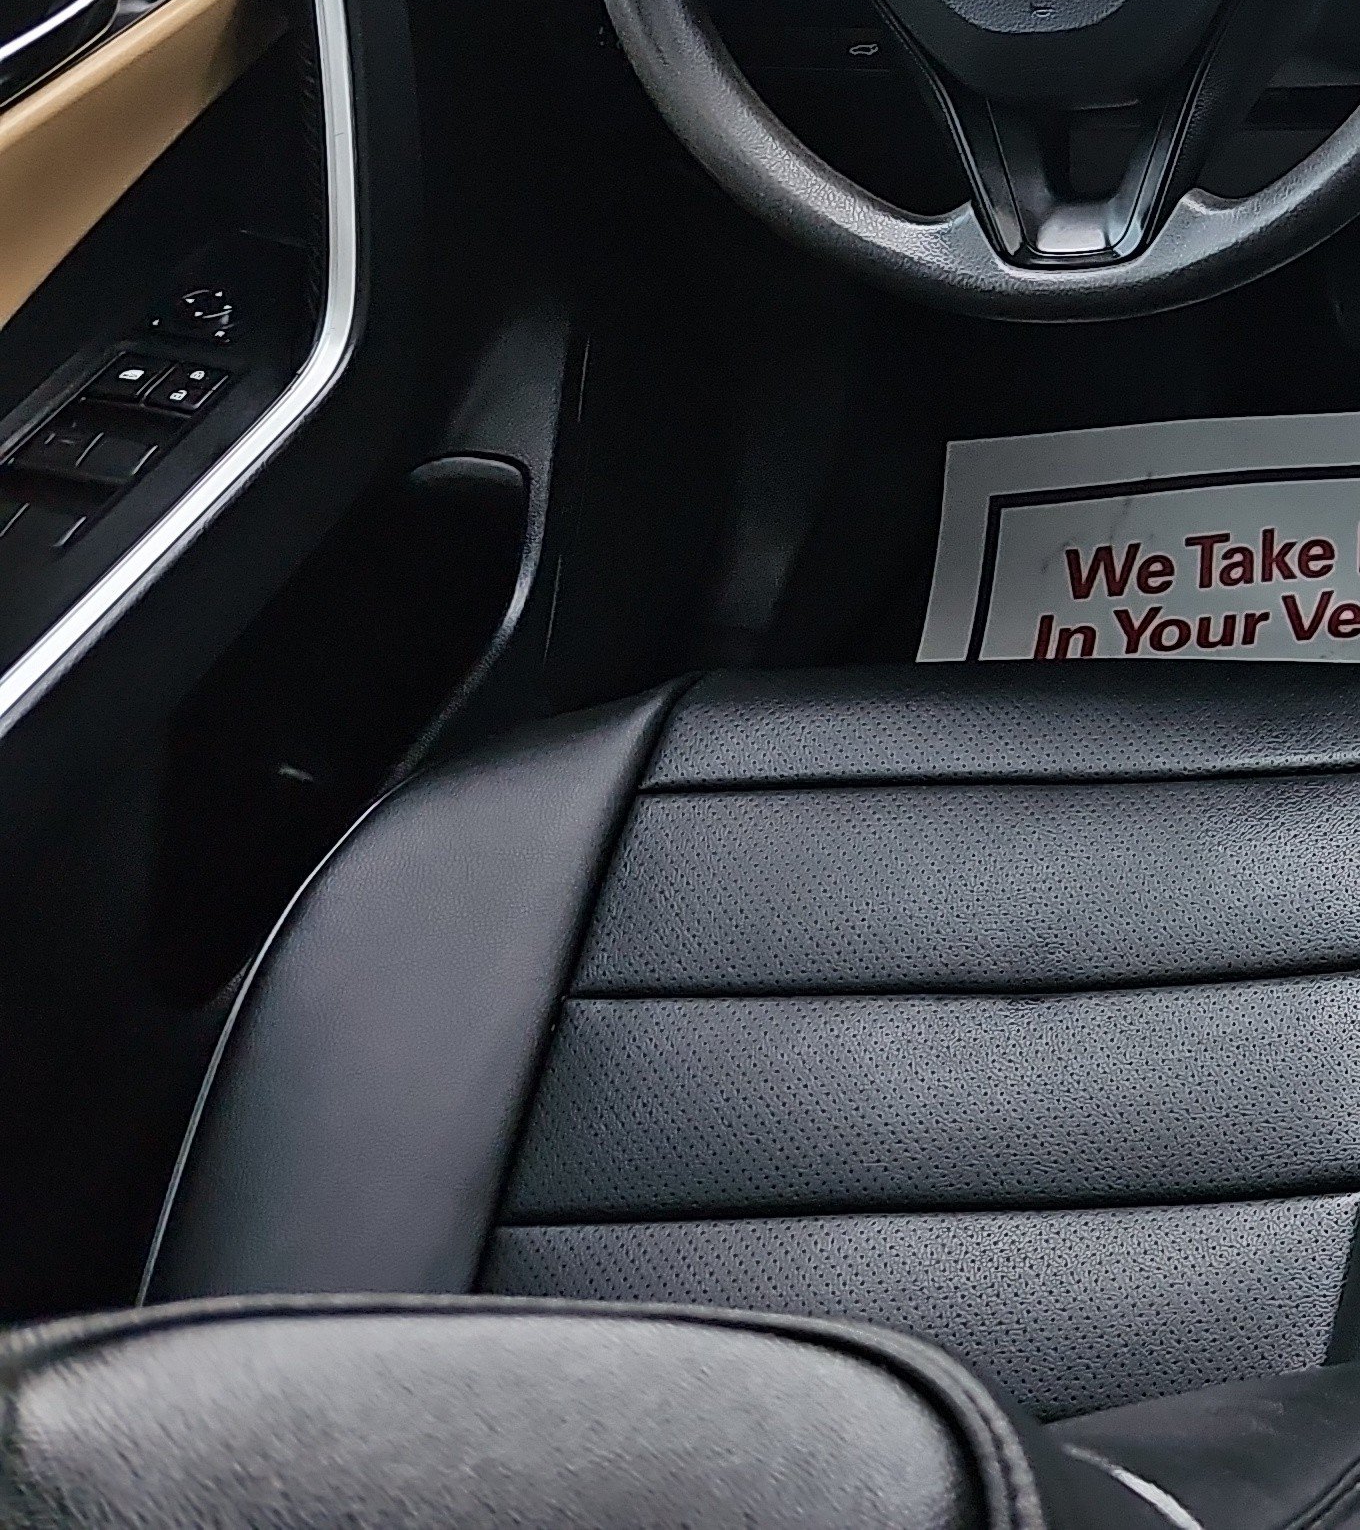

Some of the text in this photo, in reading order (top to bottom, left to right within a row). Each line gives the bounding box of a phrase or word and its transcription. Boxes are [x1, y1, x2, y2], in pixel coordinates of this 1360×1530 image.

[1065, 541, 1175, 602] We
[1185, 527, 1337, 589] Take
[1034, 613, 1097, 661] In
[1112, 606, 1270, 656] Your
